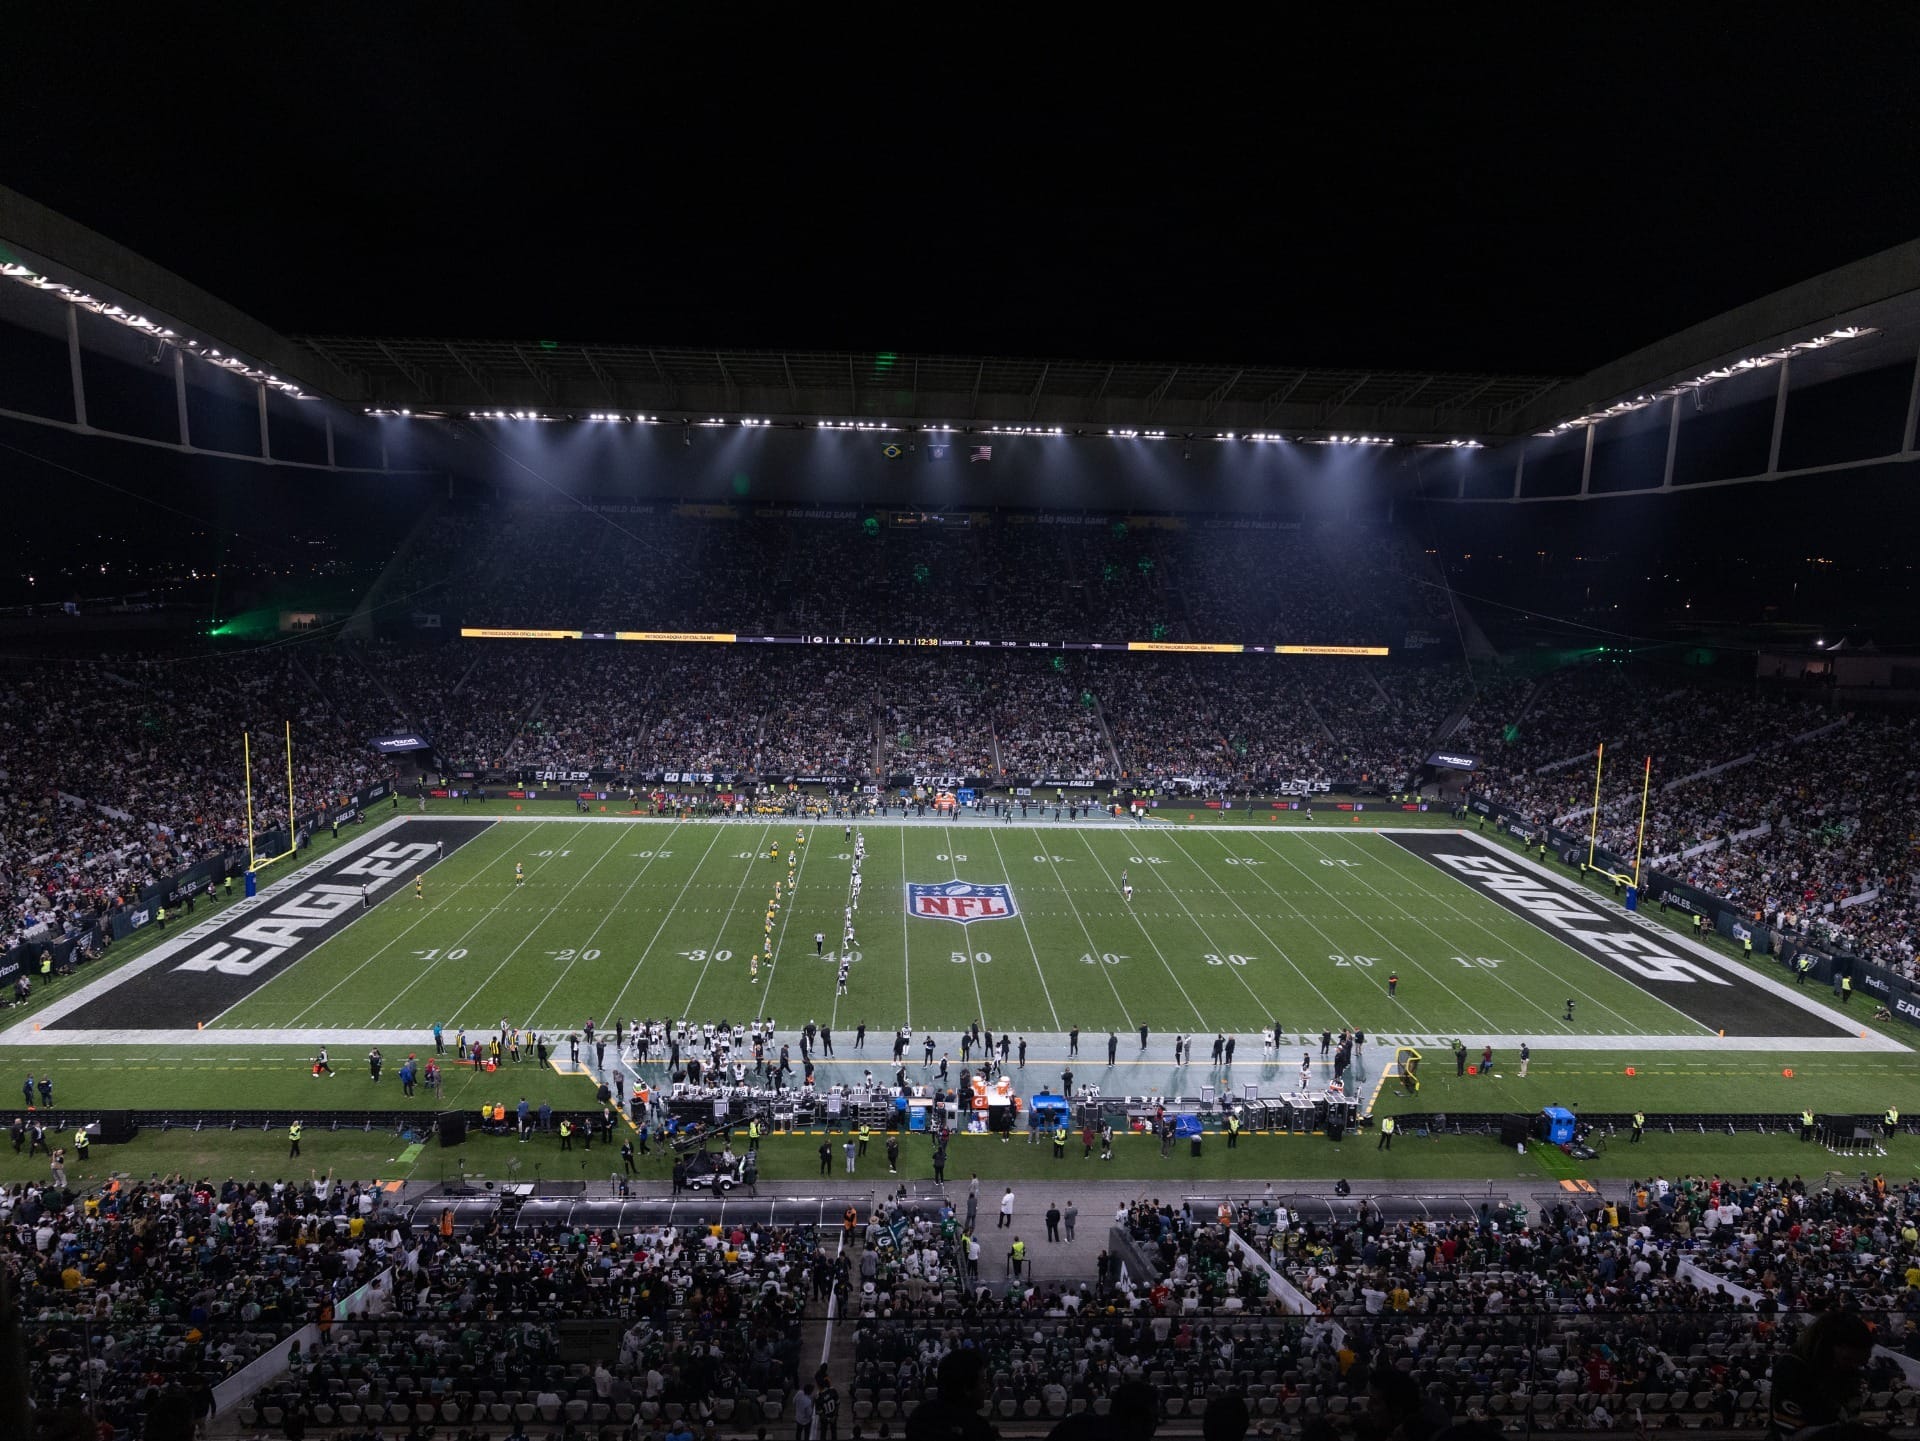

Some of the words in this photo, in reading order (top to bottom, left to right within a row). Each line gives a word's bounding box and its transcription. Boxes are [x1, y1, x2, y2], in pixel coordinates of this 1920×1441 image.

[917, 638, 938, 646] 12:38
[1438, 755, 1472, 764] verizon
[664, 773, 679, 782] GO
[920, 896, 1005, 917] NFL
[1664, 891, 1691, 910] AGLES
[168, 841, 442, 976] EAGLES
[1432, 853, 1735, 986] EAGLES
[431, 948, 468, 961] 10
[559, 949, 601, 961] 20
[689, 950, 733, 962] 30
[820, 951, 863, 962] 40
[951, 952, 992, 963] 50
[1080, 953, 1120, 965] 40
[1203, 953, 1248, 966] 30
[1328, 954, 1374, 967] 20
[1450, 956, 1498, 969] 10
[1866, 975, 1890, 992] FedEx
[974, 1098, 984, 1107] G
[823, 1399, 836, 1412] 10
